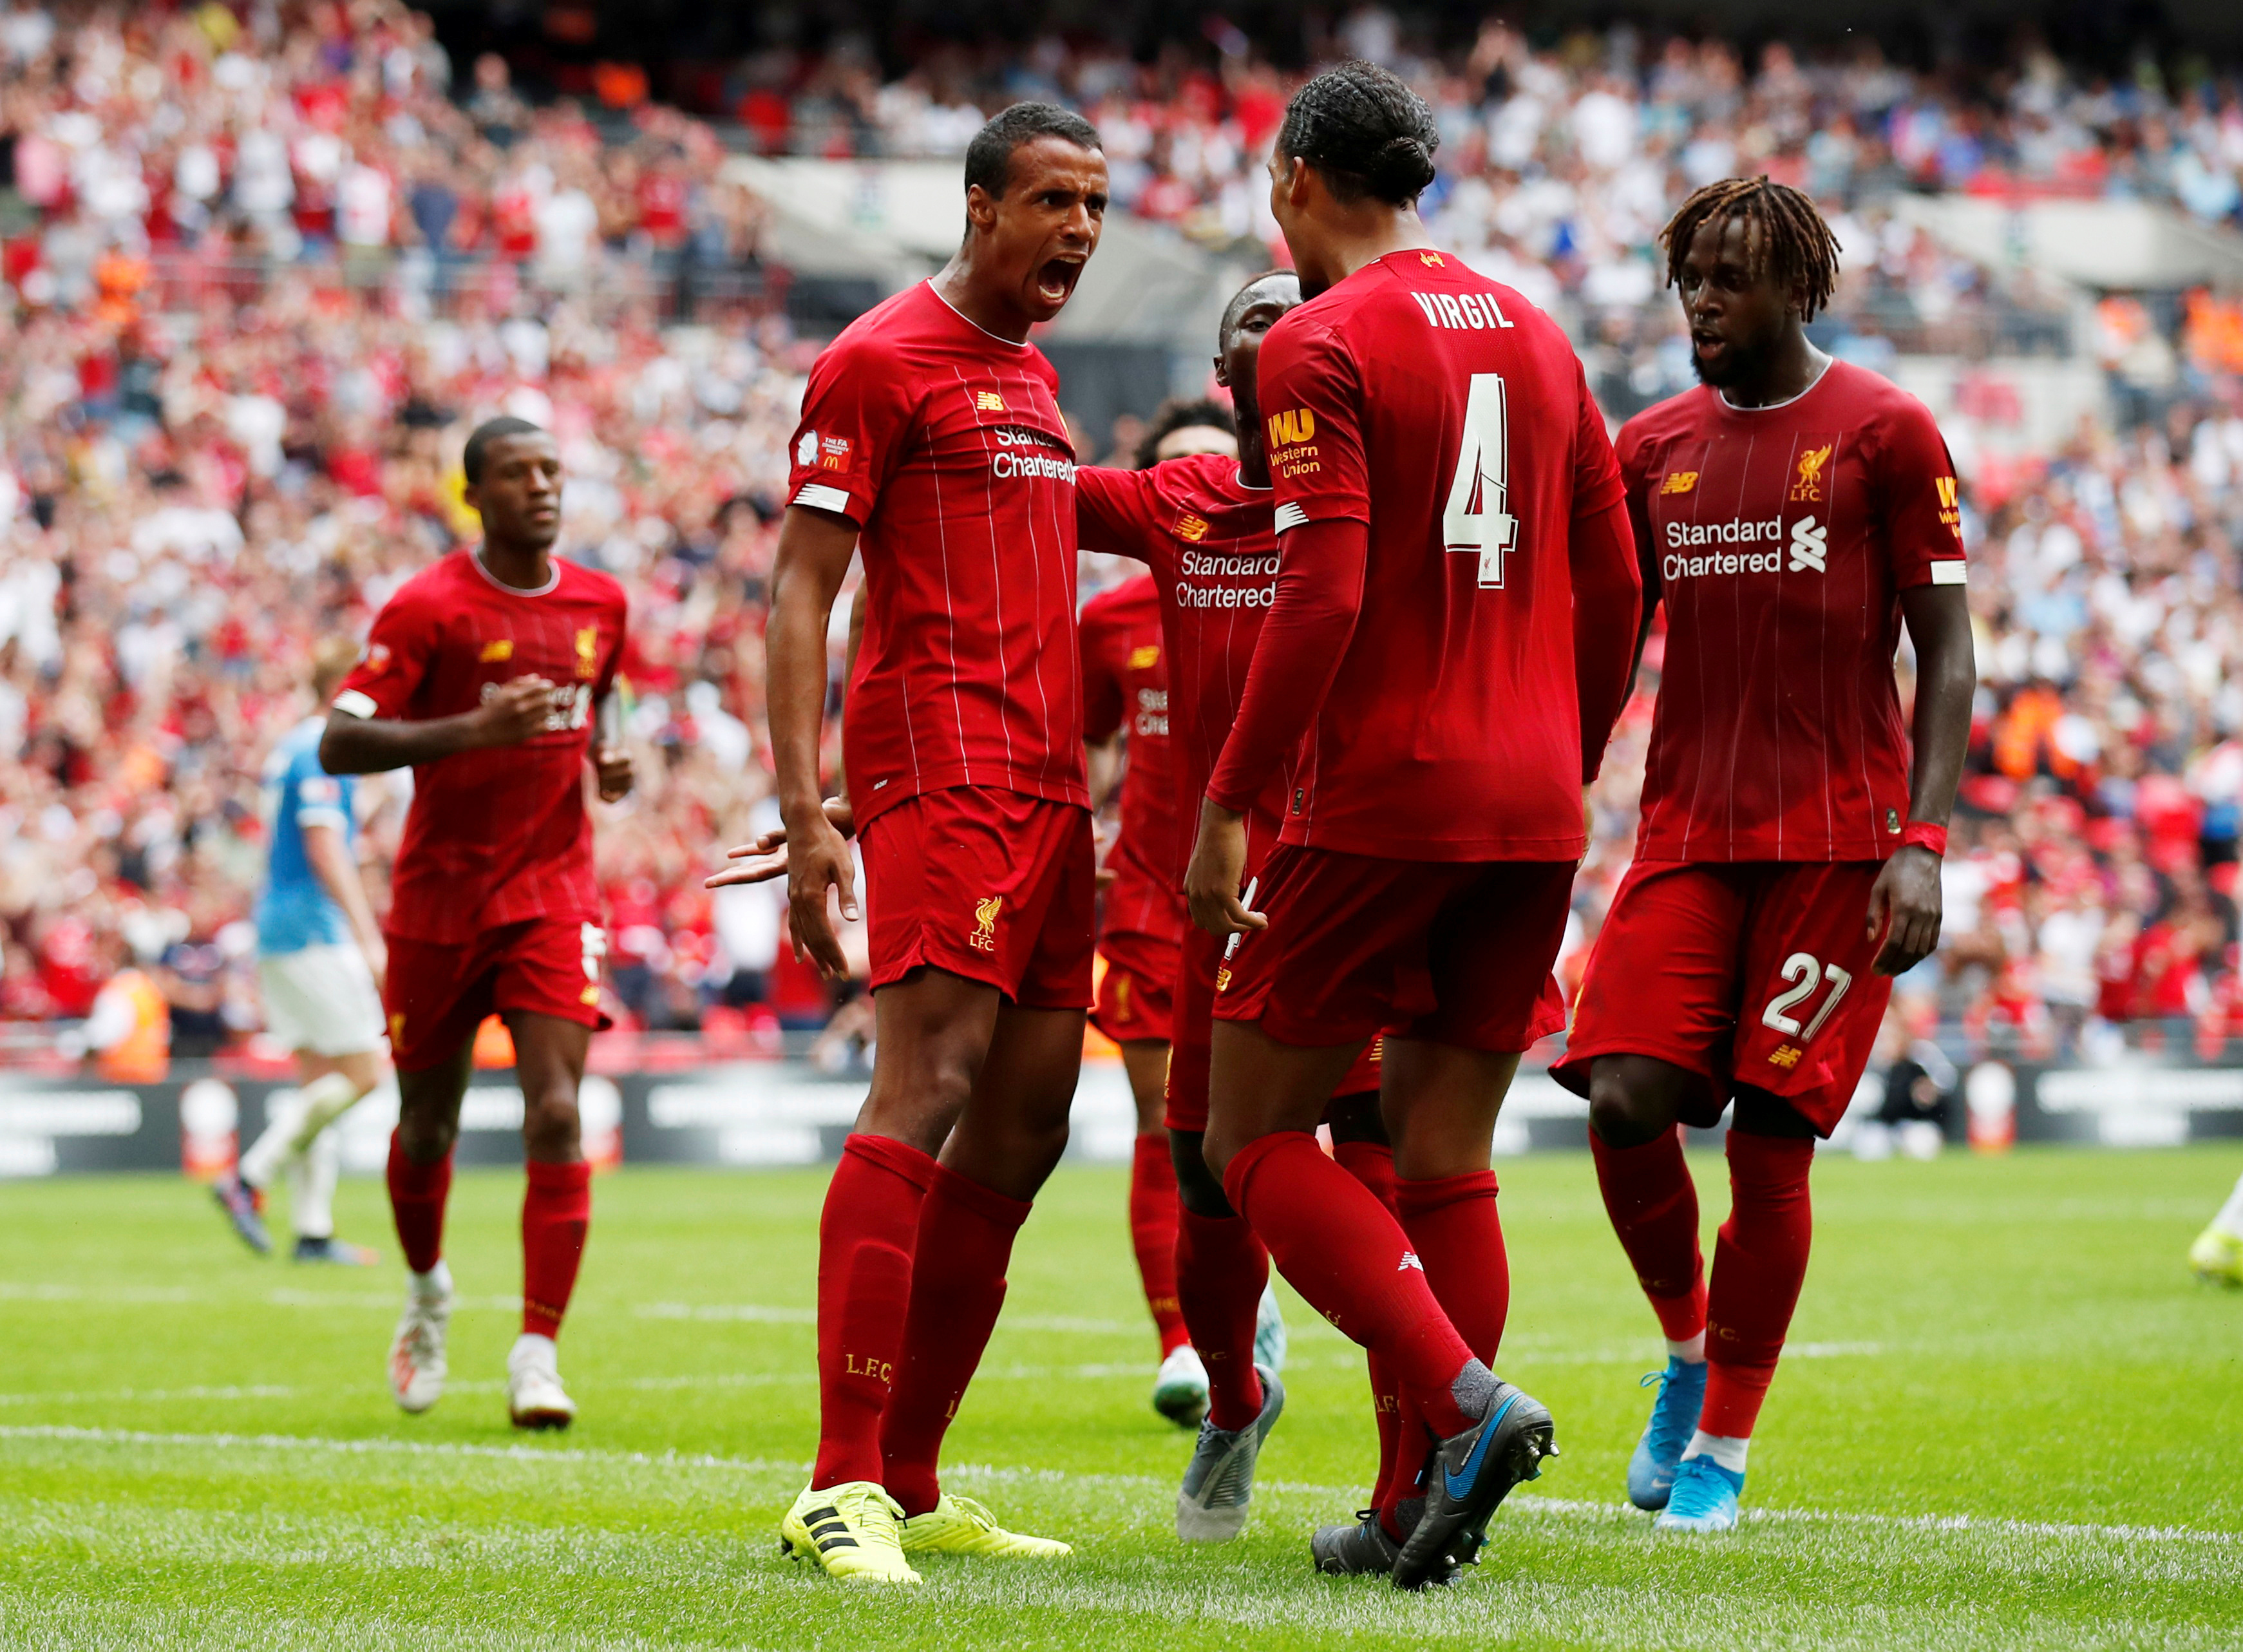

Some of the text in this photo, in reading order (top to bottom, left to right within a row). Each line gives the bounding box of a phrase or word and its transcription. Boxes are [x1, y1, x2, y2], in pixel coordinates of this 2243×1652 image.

[1410, 292, 1515, 330] VIRGIL
[1268, 408, 1314, 450] WU
[994, 451, 1072, 483] Chartered
[1270, 446, 1318, 467] Western
[1283, 459, 1320, 479] Union
[1443, 373, 1519, 589] 4
[1667, 515, 1781, 548] Standard
[1181, 551, 1281, 576] Standard
[1663, 547, 1781, 581] Chartered
[1176, 582, 1276, 608] Chartered
[1762, 952, 1852, 1044] 27
